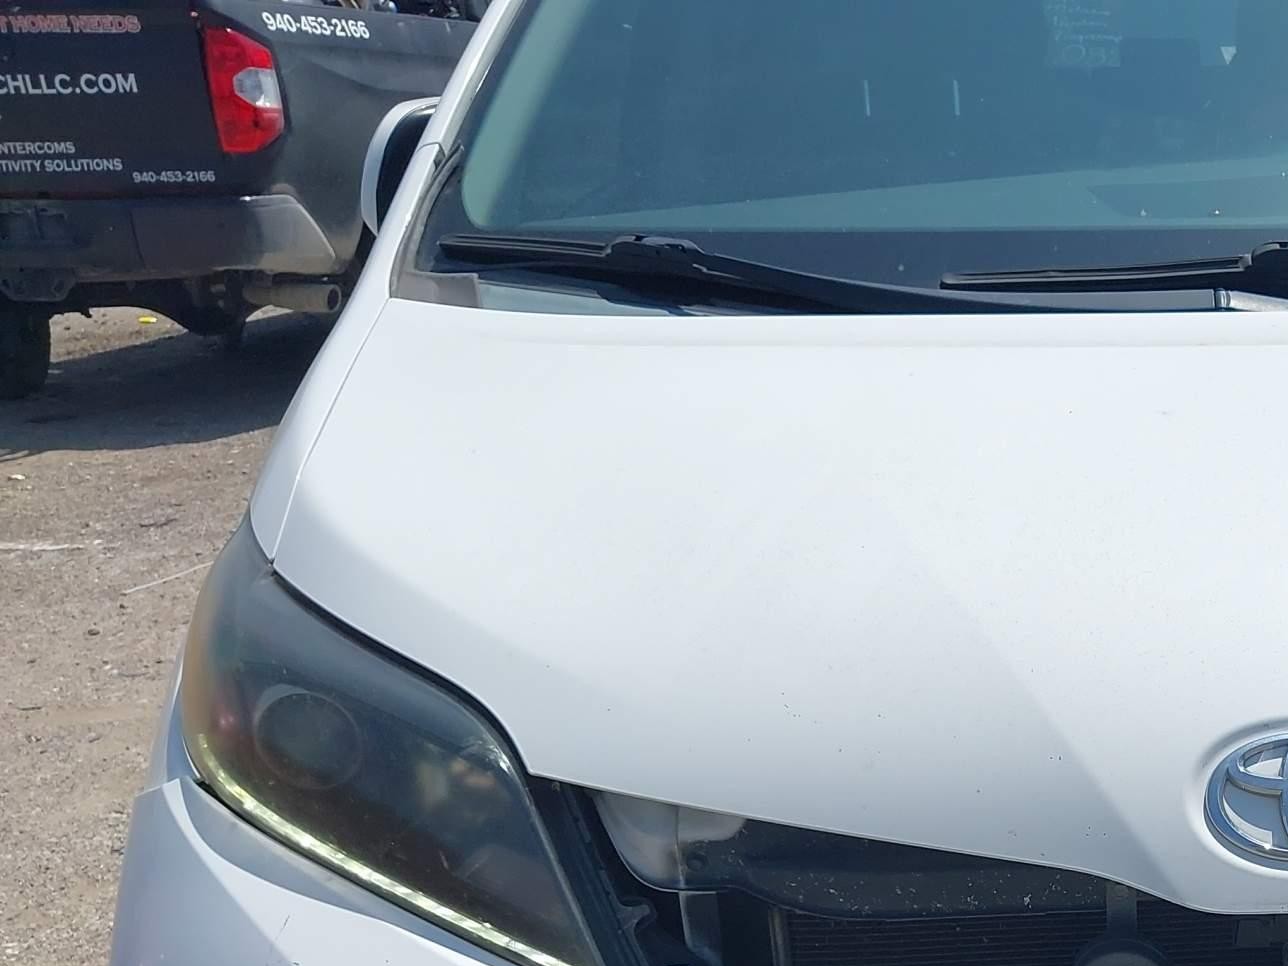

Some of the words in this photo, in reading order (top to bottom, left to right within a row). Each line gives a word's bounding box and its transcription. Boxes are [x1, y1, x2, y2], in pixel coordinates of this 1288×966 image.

[10, 15, 71, 33] HOME
[70, 15, 142, 34] NEEDS
[262, 12, 371, 39] 940-453-2166
[44, 158, 123, 172] SOLUTIONS
[133, 171, 216, 184] 940-453-2166
